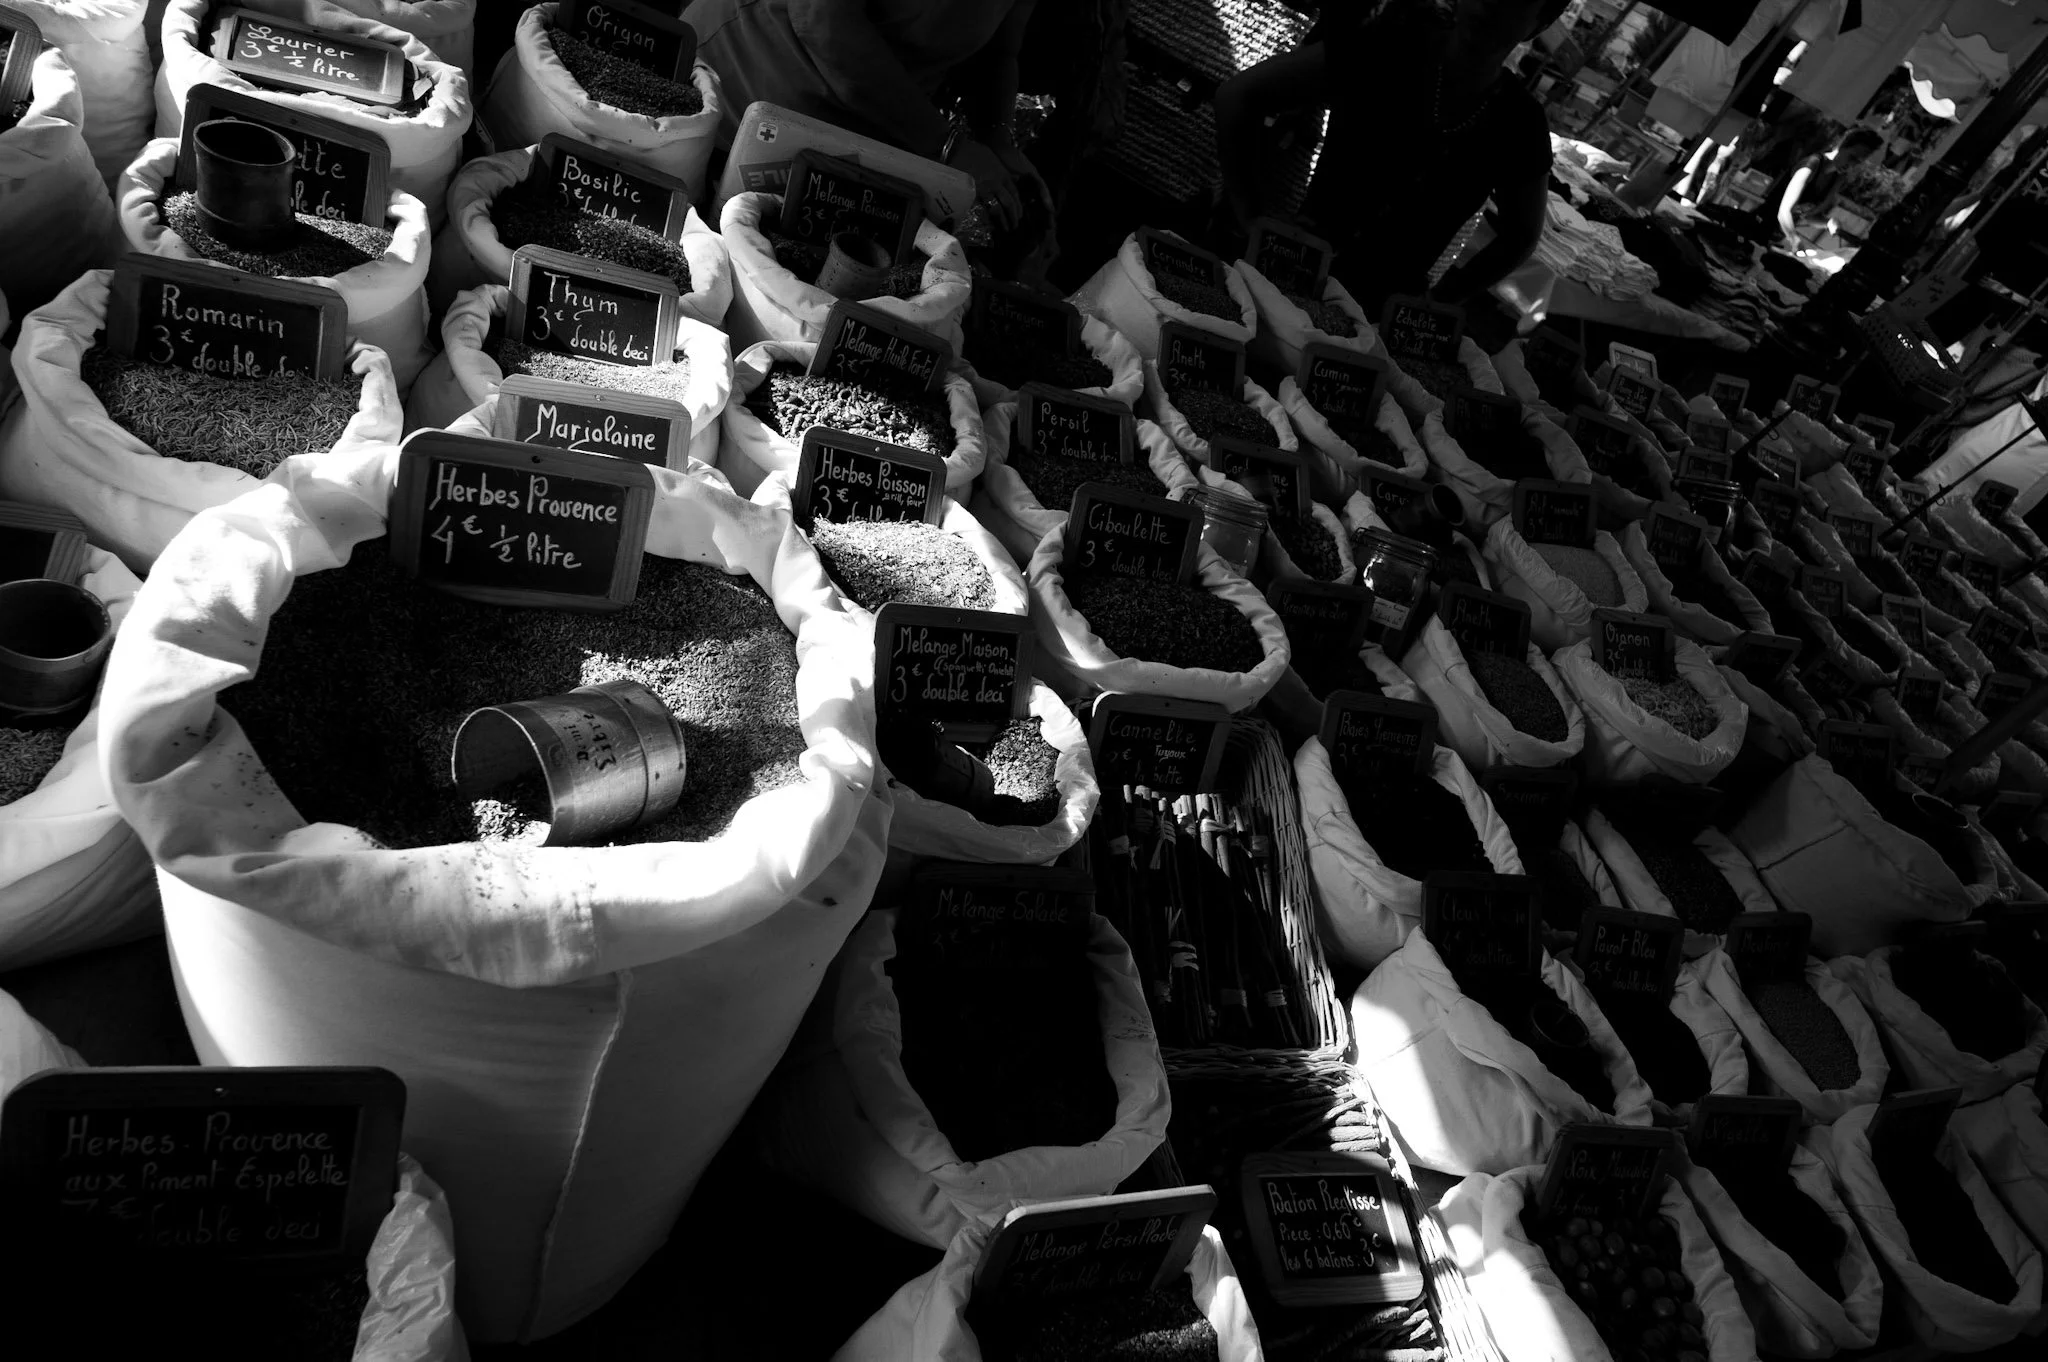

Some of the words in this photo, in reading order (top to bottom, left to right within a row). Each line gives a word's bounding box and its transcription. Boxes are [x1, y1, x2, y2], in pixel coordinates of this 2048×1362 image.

[247, 23, 355, 60] Laurier
[587, 5, 655, 53] Origan
[312, 57, 361, 82] litre
[562, 153, 642, 204] Basilic
[161, 282, 285, 340] Romarin
[543, 271, 619, 321] Thym
[191, 342, 263, 381] double
[570, 325, 619, 357] double
[622, 335, 649, 361] deci
[909, 350, 934, 381] Forte
[524, 402, 656, 452] Marjolaine
[1040, 401, 1090, 434] Persil
[1061, 435, 1098, 462] double
[429, 460, 521, 512] Herbes
[527, 473, 619, 524] Provence
[814, 446, 874, 485] Herbes
[876, 459, 927, 499] Poisson
[1089, 502, 1173, 545] Ciboulette
[525, 531, 583, 570] litre
[1111, 550, 1146, 580] double
[893, 625, 958, 662] Melange
[955, 631, 1009, 665] Maison
[1605, 621, 1651, 652] Oignon
[921, 672, 970, 703] double
[1109, 713, 1198, 744] Cannelle
[931, 886, 1008, 924] Melange
[1012, 889, 1070, 925] Salade
[57, 1114, 177, 1163] Herbes
[202, 1110, 334, 1156] Provence
[64, 1172, 129, 1194] aux
[140, 1157, 226, 1191] Piment
[232, 1152, 350, 1206] Espelette
[1266, 1179, 1318, 1217] Baton
[1316, 1177, 1381, 1214] Reglisse
[134, 1200, 244, 1248] double
[1094, 1214, 1178, 1251] Persillade
[1279, 1221, 1313, 1243] Piece
[1279, 1245, 1301, 1273] les
[1303, 1248, 1314, 1271] 6
